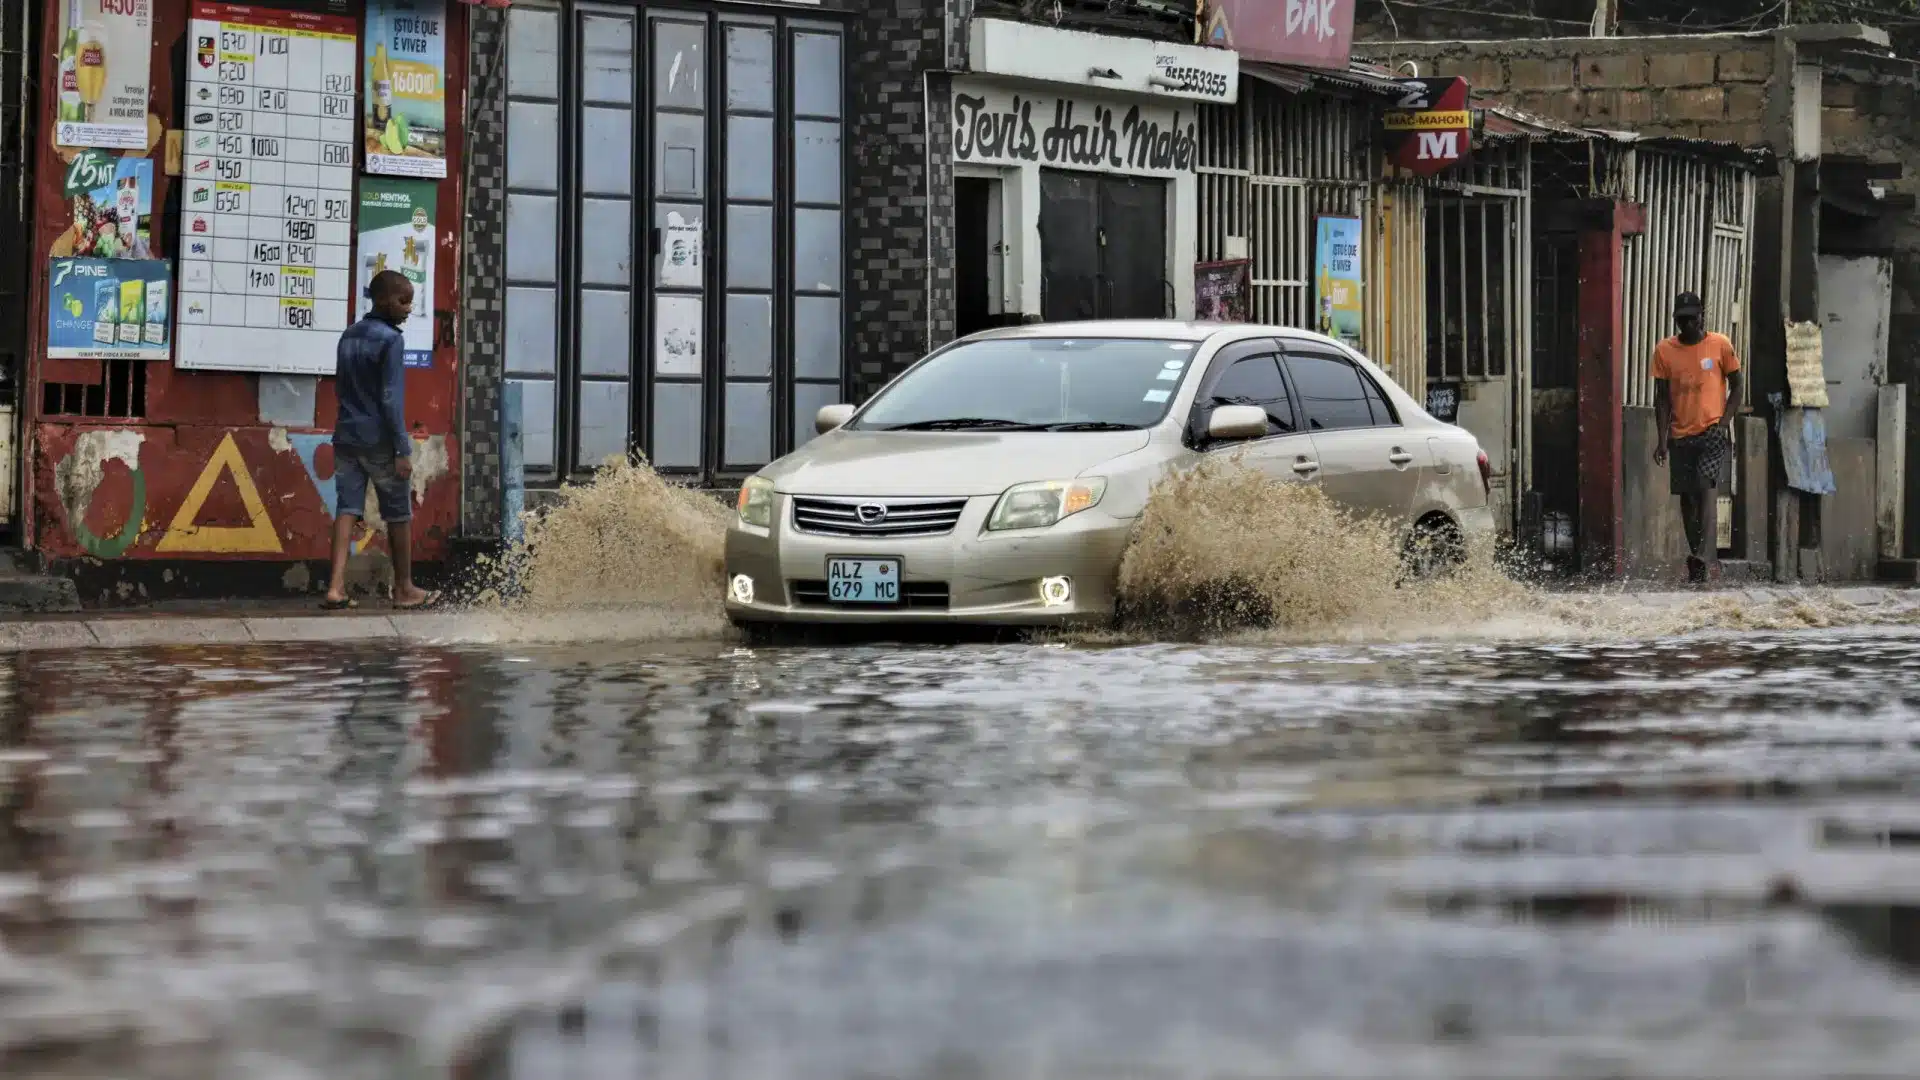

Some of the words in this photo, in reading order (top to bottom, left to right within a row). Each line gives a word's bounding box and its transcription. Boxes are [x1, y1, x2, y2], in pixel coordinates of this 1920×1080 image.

[421, 20, 438, 37] QUE
[401, 38, 427, 53] VIVER
[218, 135, 242, 154] 450
[251, 137, 279, 156] 1000
[1122, 104, 1197, 174] Maker
[1417, 132, 1459, 160] M
[68, 152, 97, 189] 25
[98, 164, 115, 185] MT
[217, 160, 242, 179] 450
[286, 194, 316, 217] 1240
[380, 192, 411, 202] MENTHOL
[74, 265, 108, 277] PINE
[250, 268, 275, 288] 1700
[832, 562, 862, 579] ALZ
[832, 582, 863, 598] 679
[875, 581, 895, 598] MC
